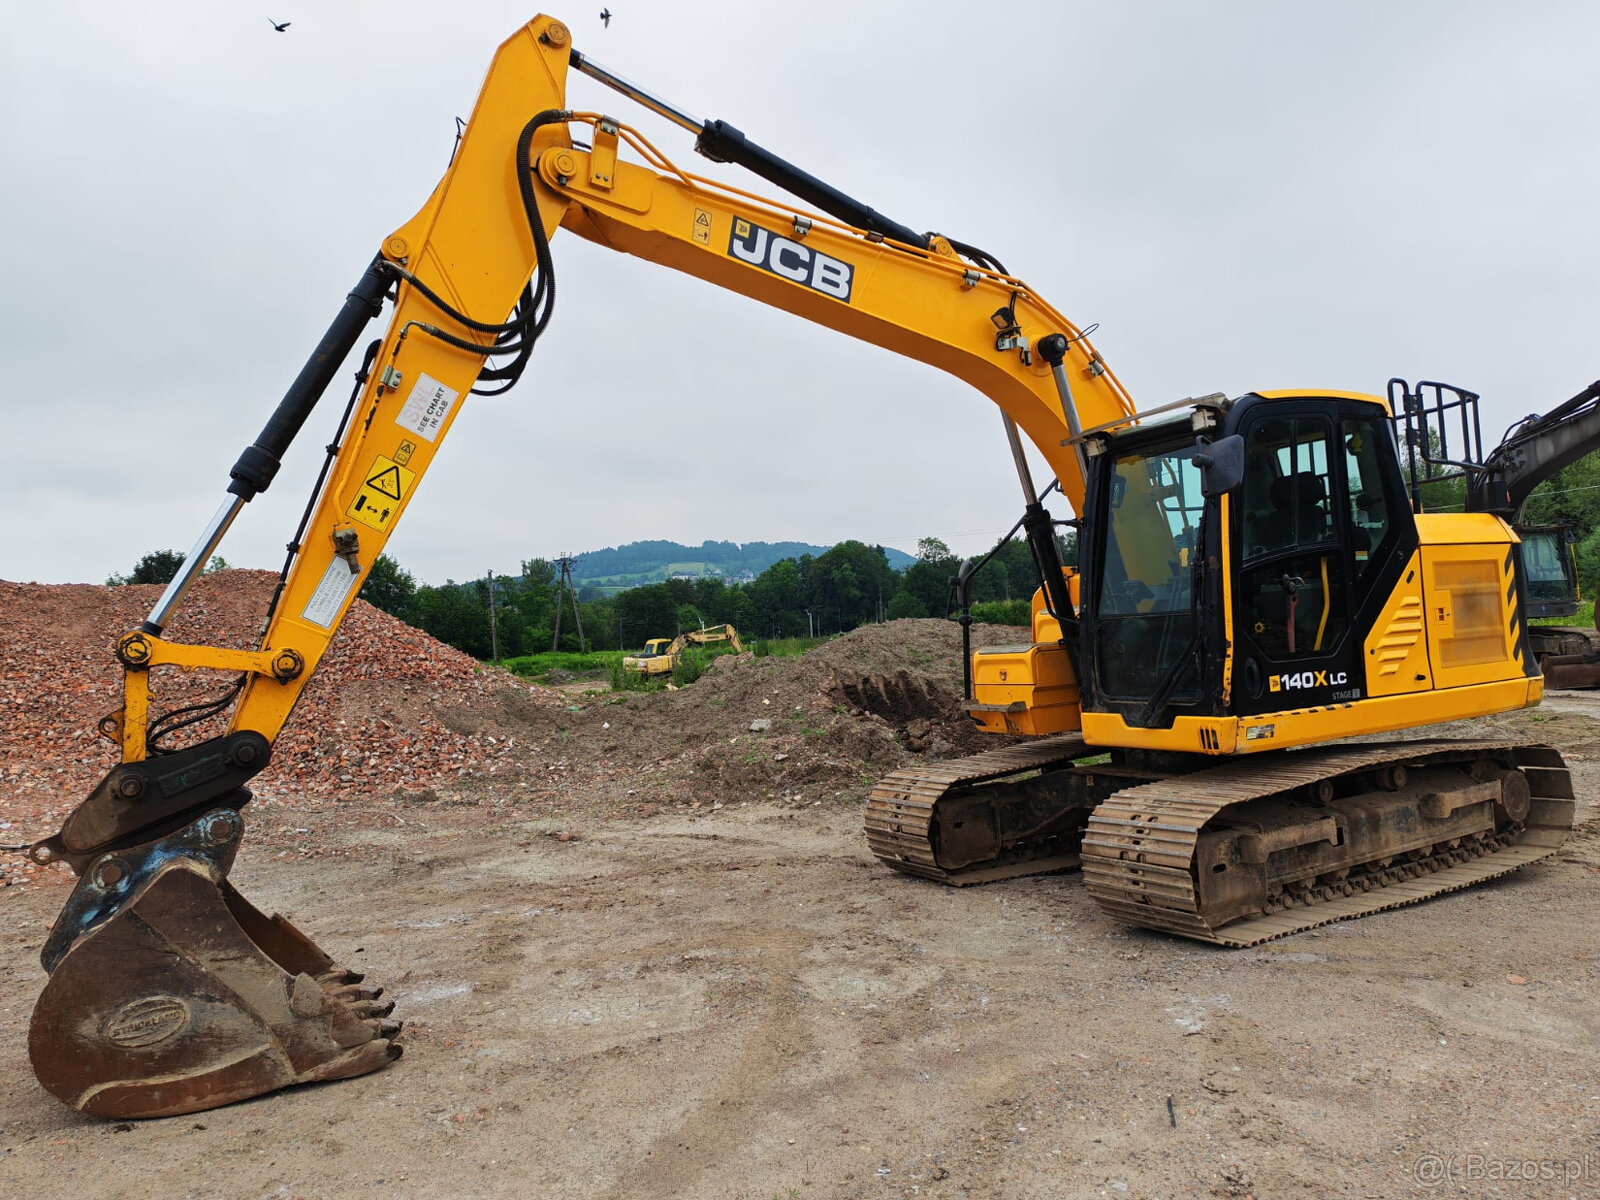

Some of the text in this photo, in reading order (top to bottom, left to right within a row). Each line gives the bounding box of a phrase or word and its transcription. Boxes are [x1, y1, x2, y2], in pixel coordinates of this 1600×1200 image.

[732, 227, 851, 299] JCB
[417, 386, 446, 433] SEE CHART
[429, 399, 449, 429] IN CAB
[1281, 670, 1329, 691] 140X
[1330, 672, 1348, 686] LC
[1332, 690, 1352, 700] STAGE
